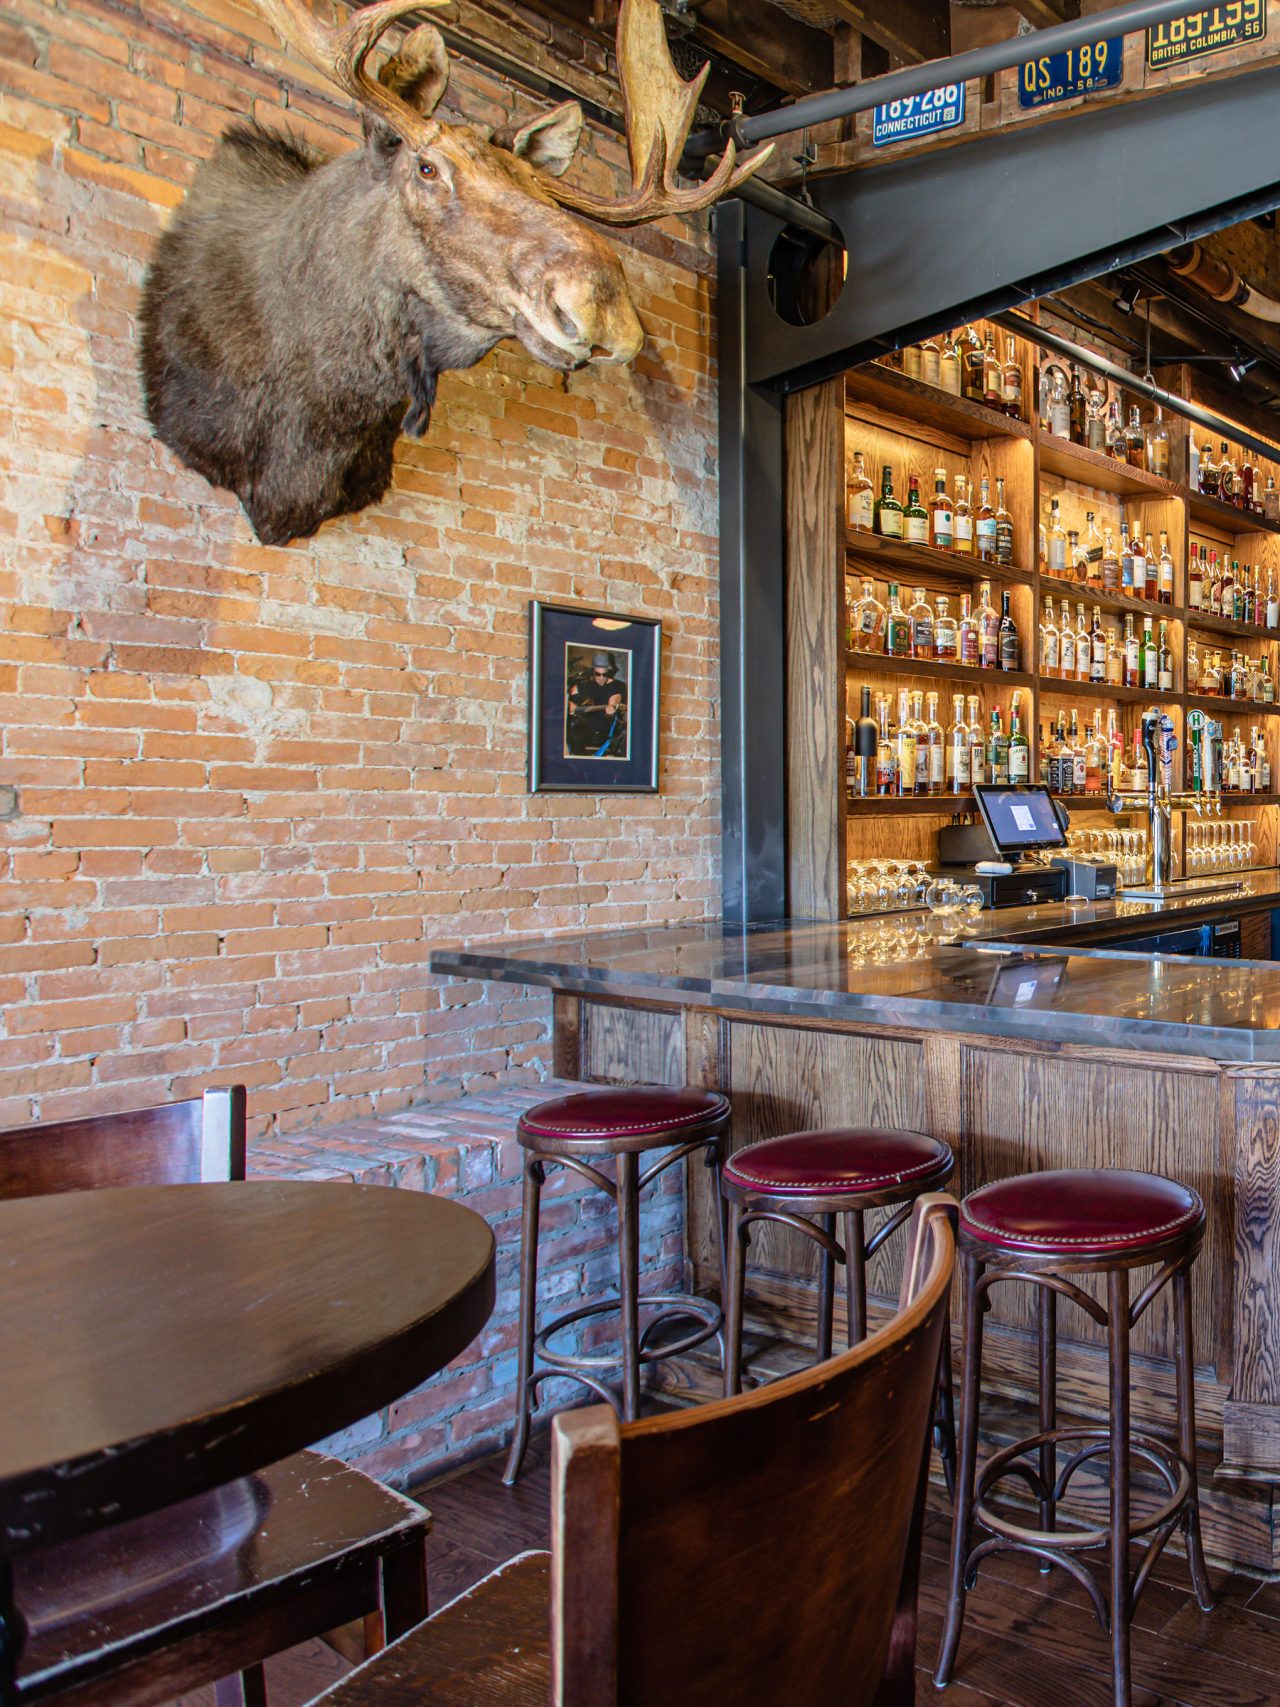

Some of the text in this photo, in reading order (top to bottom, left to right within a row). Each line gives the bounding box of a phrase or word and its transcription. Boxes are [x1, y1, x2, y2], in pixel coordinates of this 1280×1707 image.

[1152, 21, 1260, 61] BRITISH COLUMBIA 56
[1025, 41, 1108, 92] QS 189
[876, 109, 942, 137] CONNECTICUT
